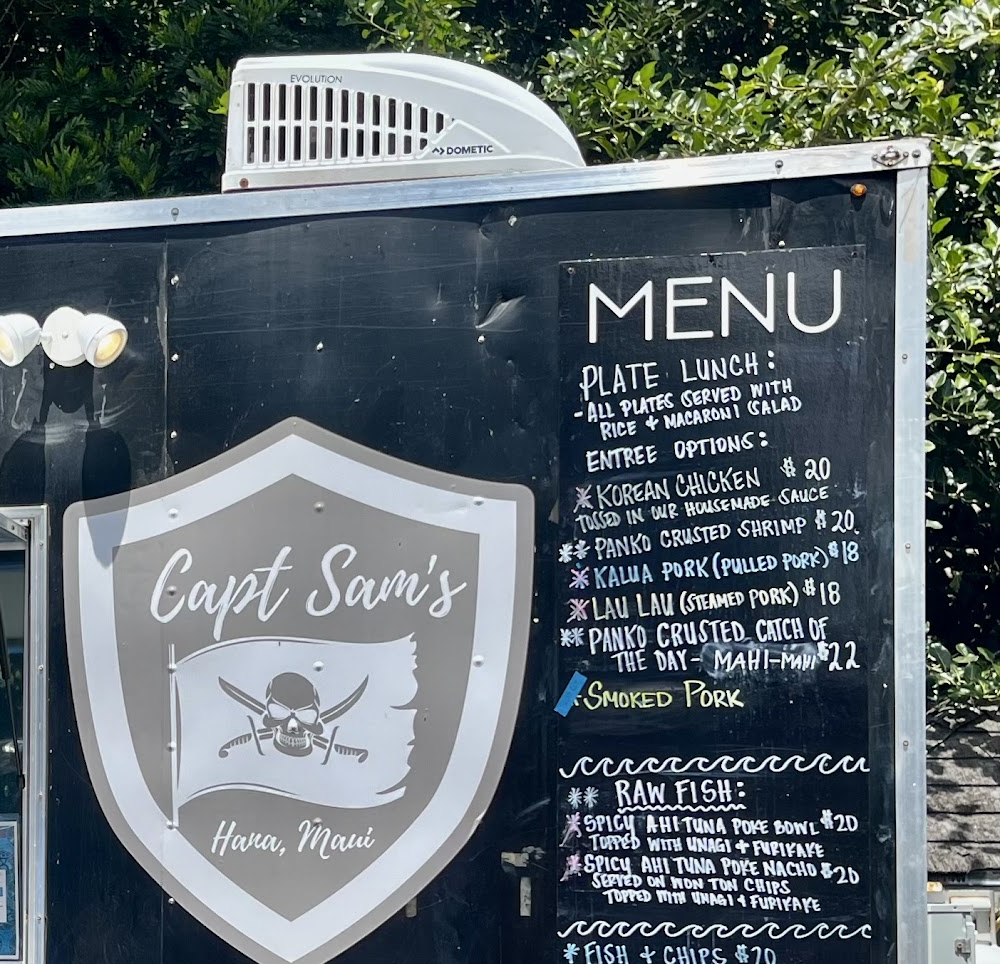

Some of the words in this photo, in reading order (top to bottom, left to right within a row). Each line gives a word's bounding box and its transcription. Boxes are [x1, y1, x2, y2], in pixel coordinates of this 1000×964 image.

[290, 74, 343, 84] EVOLUTION
[446, 145, 493, 155] DOMETIC
[588, 269, 841, 343] MENU
[579, 362, 659, 401] PLATE
[621, 393, 673, 418] PLATES
[681, 388, 741, 406] SERVED
[750, 378, 792, 398] WITH
[600, 420, 636, 440] RICE
[663, 406, 740, 429] MACARONI
[748, 397, 802, 416] SALAD
[586, 446, 657, 472] ENTREE
[596, 478, 670, 510] KOREAN
[676, 467, 760, 498] CHICKEN
[575, 512, 621, 534] TOSSED
[626, 509, 645, 525] IN
[651, 504, 679, 522] OUR
[685, 494, 771, 515] HOUSEMADE
[778, 485, 829, 504] SAUCE
[595, 532, 651, 560] PANKO
[660, 524, 730, 549] CRUSTED
[737, 517, 807, 539] SHRIMP
[594, 564, 653, 590] KALUA
[662, 556, 708, 581] PORK
[828, 541, 859, 565] $18
[150, 546, 293, 641] Capt
[306, 544, 467, 618] Sam's
[592, 595, 629, 621] LAU
[637, 592, 673, 617] LAU
[802, 577, 841, 606] $18
[589, 625, 647, 654] PANKO
[656, 619, 743, 649] CRUSTED
[755, 617, 802, 643] CATCH
[809, 616, 829, 640] OF
[611, 649, 648, 673] THE
[714, 648, 817, 671] MAHI-MAHI
[615, 779, 665, 808] RAW
[211, 820, 286, 856] Hana,
[298, 819, 375, 859] Maui
[584, 814, 635, 836] SPICY
[646, 817, 679, 833] AHI
[681, 817, 727, 835] TUNA
[731, 817, 769, 835] POKE
[774, 819, 820, 835] BOWL
[820, 809, 859, 832] $20
[589, 833, 640, 851] TOPPED
[647, 836, 682, 852] WITH
[686, 837, 731, 853] UNAGI
[752, 839, 824, 858] FURIKAKE
[584, 855, 631, 876] SPICY
[641, 856, 670, 874] AHI
[673, 857, 717, 875] TUNA
[721, 858, 760, 877] POKE
[763, 859, 817, 878] NACHO
[591, 875, 642, 890] SERVED
[647, 876, 666, 889] ON
[672, 877, 704, 891] WON
[708, 878, 738, 892] TON
[743, 879, 791, 895] CHIPS
[602, 889, 651, 905] TOPPED
[656, 890, 686, 904] WITH
[691, 892, 734, 907] UNAGI
[750, 895, 821, 913] FURIKAKE
